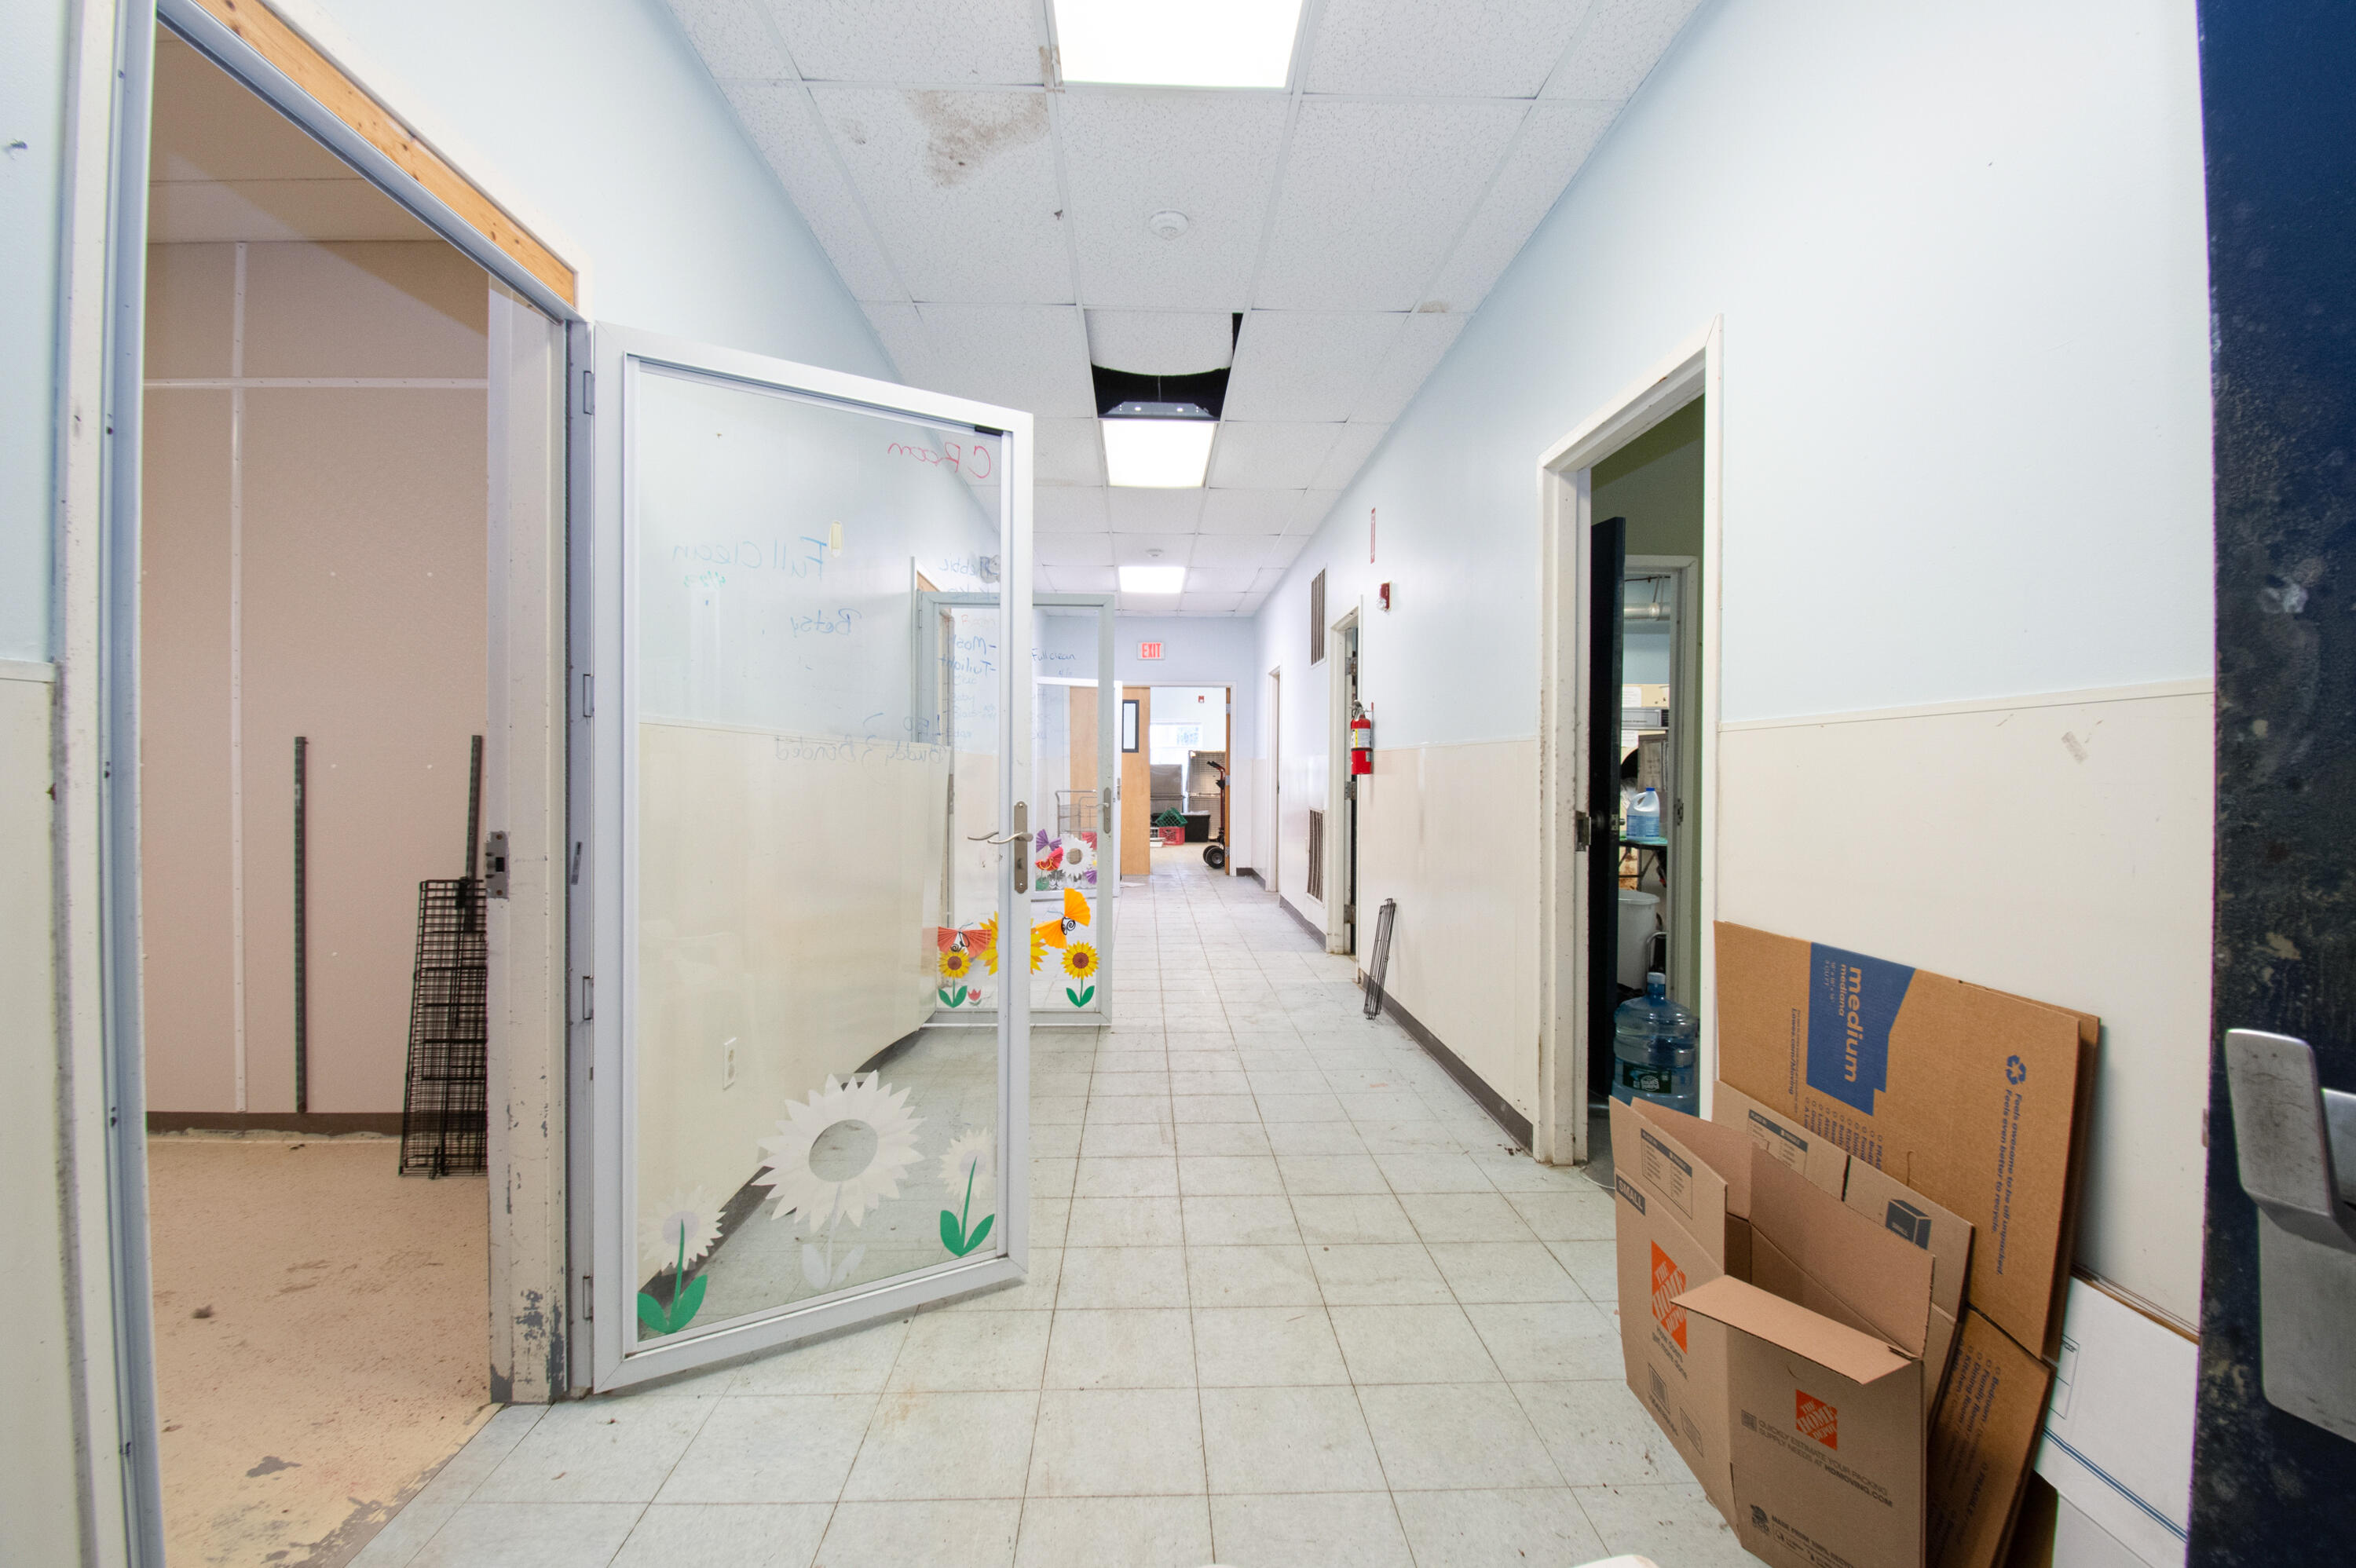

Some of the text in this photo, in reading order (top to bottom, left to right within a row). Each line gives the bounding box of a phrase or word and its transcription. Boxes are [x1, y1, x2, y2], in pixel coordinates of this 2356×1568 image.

[1142, 642, 1162, 658] EXIT
[1838, 963, 1847, 1017] mediana
[1843, 966, 1864, 1083] medium
[2003, 1089, 2013, 1116] Feels
[2014, 1093, 2022, 1120] Feels
[1997, 1146, 2007, 1179] better
[2008, 1123, 2018, 1174] awesome
[1619, 1179, 1643, 1211] SMALL
[1996, 1181, 2003, 1192] to
[2007, 1176, 2013, 1187] to
[2005, 1189, 2012, 1204] be
[1655, 1261, 1670, 1284] THE
[1652, 1267, 1686, 1321] HOME
[1956, 1354, 1973, 1393] Kitchen
[1966, 1361, 1981, 1394] Dining
[1974, 1367, 1992, 1402] Family
[1802, 1401, 1815, 1413] THE
[1958, 1395, 1972, 1424] Room
[1981, 1375, 1999, 1424] Bedroom
[1797, 1405, 1836, 1432] HOME
[1812, 1424, 1837, 1440] DEPOT
[1966, 1403, 1981, 1432] Room
